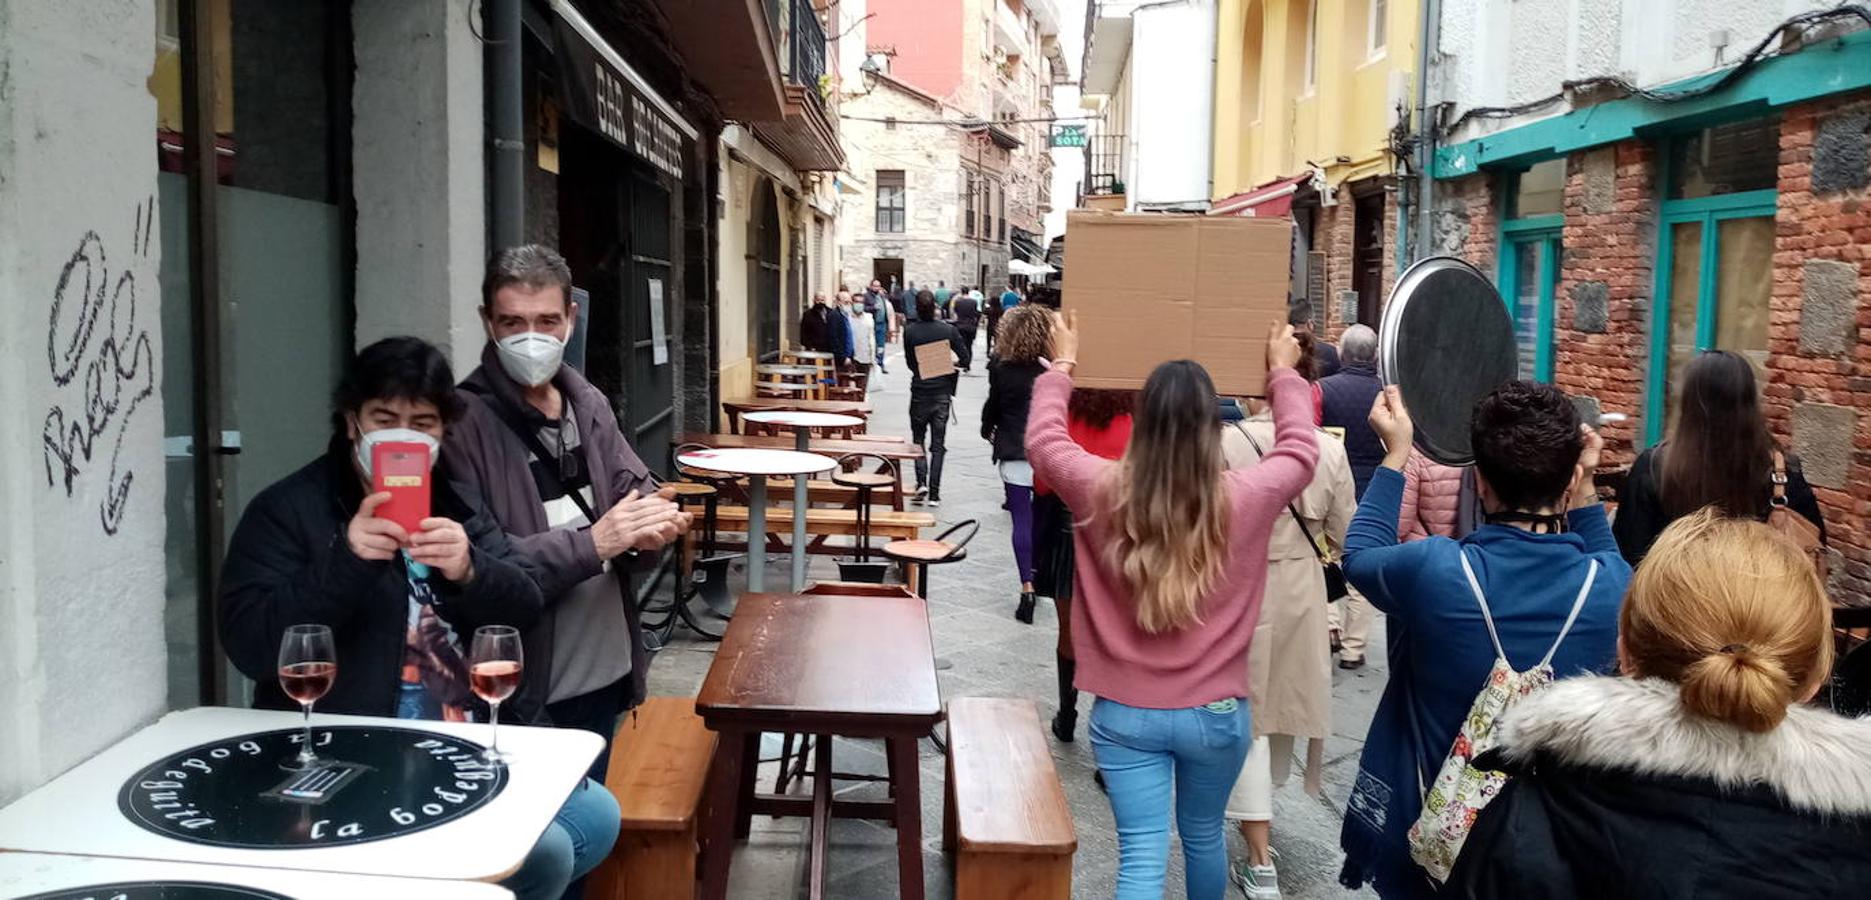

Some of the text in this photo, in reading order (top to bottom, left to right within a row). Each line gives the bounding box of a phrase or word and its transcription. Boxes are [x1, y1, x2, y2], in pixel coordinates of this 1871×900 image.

[595, 62, 627, 145] BAR
[1055, 135, 1087, 147] SOTA
[140, 740, 263, 829] bodeguita
[310, 739, 496, 840] la bodeguita
